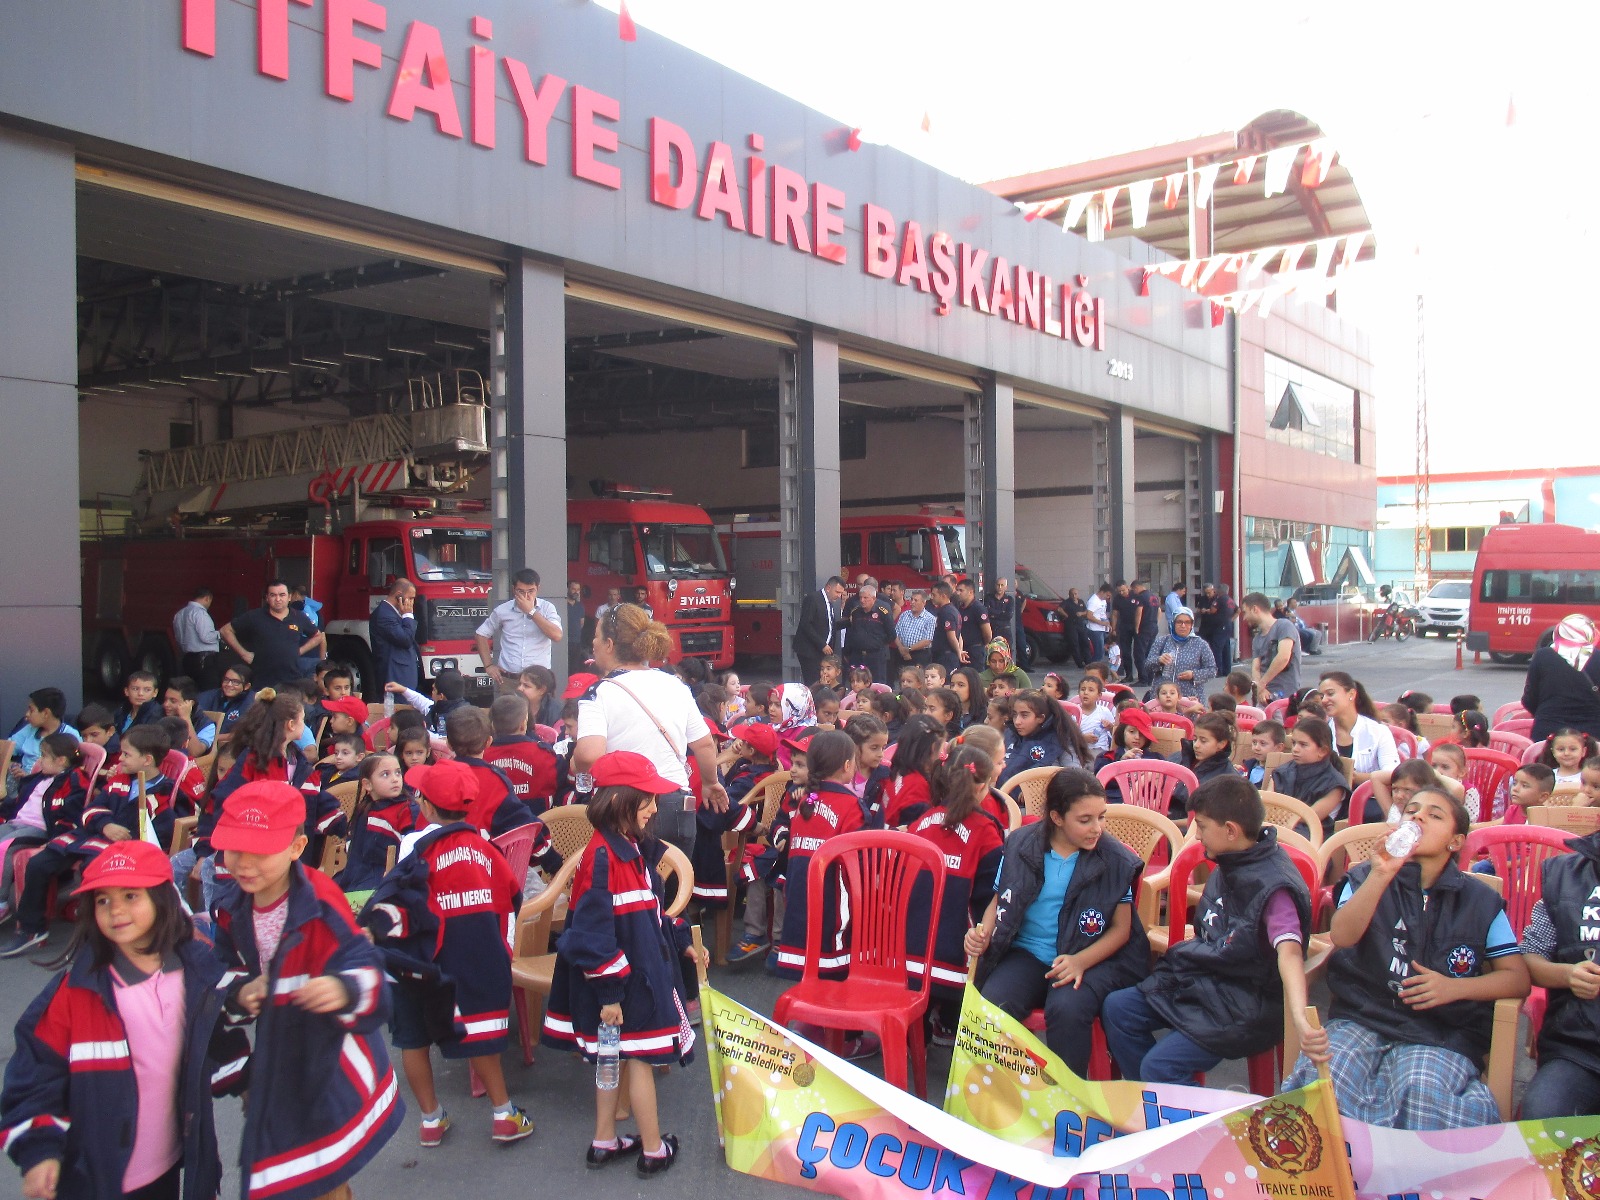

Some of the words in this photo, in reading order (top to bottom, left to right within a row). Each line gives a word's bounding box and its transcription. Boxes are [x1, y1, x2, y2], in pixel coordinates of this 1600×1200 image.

[650, 116, 847, 264] DAİRE
[864, 202, 1105, 351] BAŞKANLIĞI
[1509, 615, 1531, 625] 110
[246, 814, 260, 823] 110
[110, 859, 126, 868] 110
[436, 890, 461, 911] ĞİTİM
[714, 1024, 797, 1065] hramanmaraş
[744, 1052, 793, 1077] Belediyesi
[993, 1053, 1039, 1077] Belediyesi
[797, 1111, 975, 1194] ÇOCUK
[1255, 1180, 1298, 1197] İTFAİYE
[1300, 1183, 1335, 1198] DAİRE
